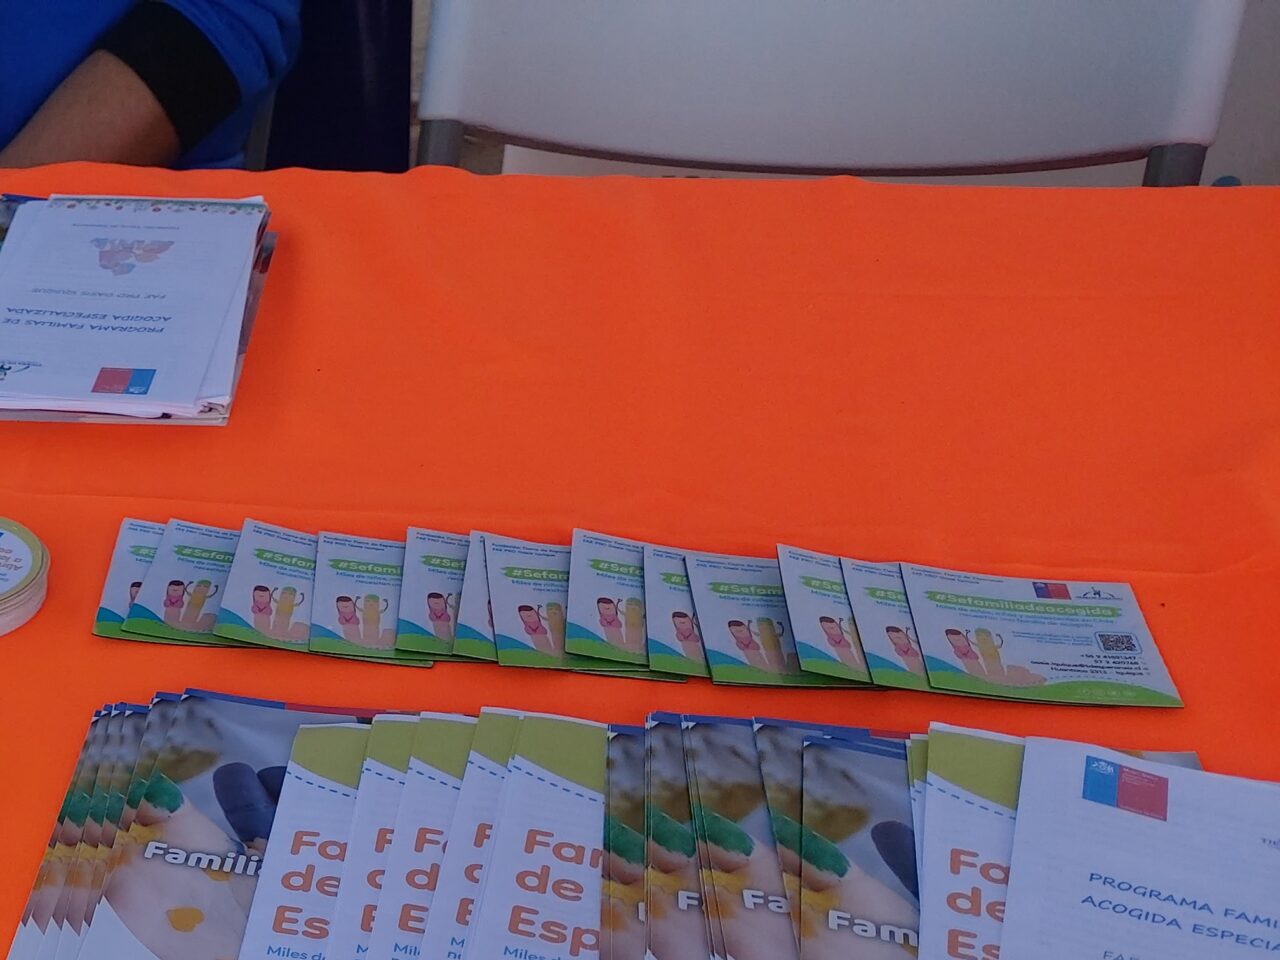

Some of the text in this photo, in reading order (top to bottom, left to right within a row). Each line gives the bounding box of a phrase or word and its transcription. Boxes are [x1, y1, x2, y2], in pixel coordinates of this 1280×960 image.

[1, 317, 165, 335] PROGRAMA FAMILIAS DE
[6, 307, 172, 324] ACOGIDA ESPECIALIZADA
[144, 840, 262, 877] Famili
[290, 830, 349, 862] Fa
[281, 864, 341, 898] de
[515, 865, 584, 902] de
[949, 847, 1011, 887] Fa
[946, 886, 1006, 924] de
[1089, 872, 1215, 915] PROGRAMA
[272, 905, 331, 940] Es
[508, 905, 600, 957] Esp
[828, 909, 919, 947] Fam
[1081, 895, 1183, 931] ACOGIDA
[266, 945, 308, 960] Miles
